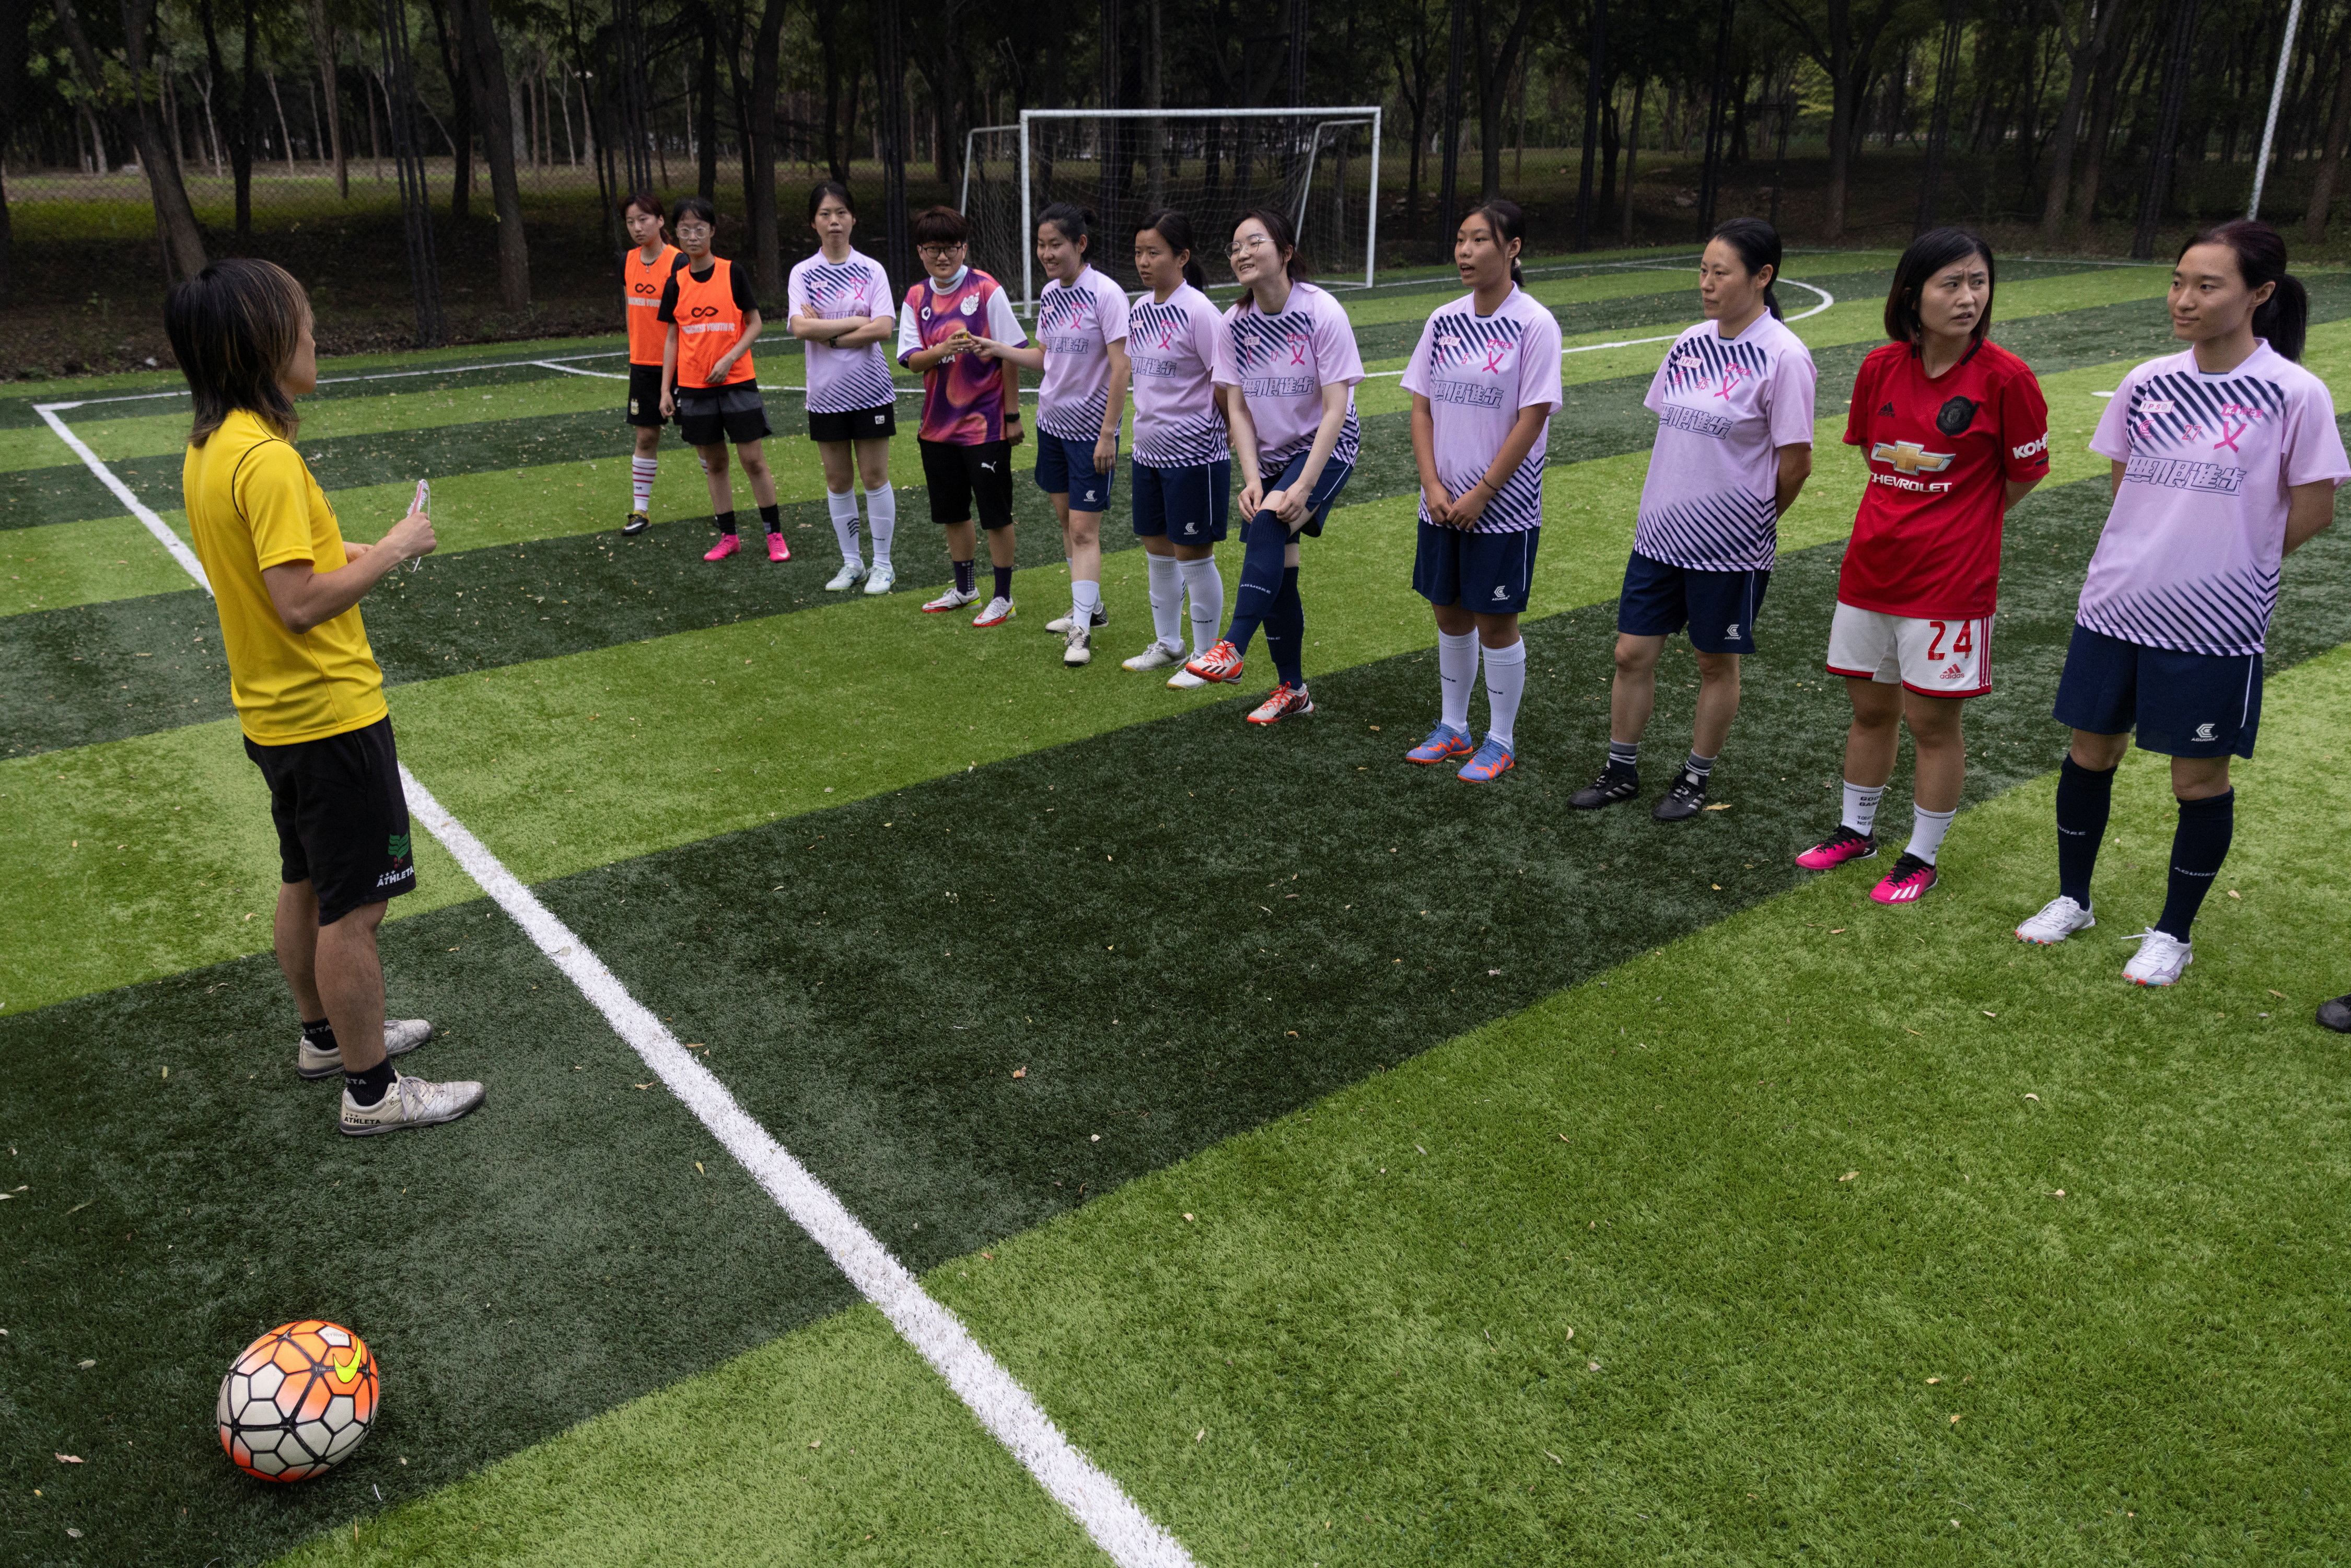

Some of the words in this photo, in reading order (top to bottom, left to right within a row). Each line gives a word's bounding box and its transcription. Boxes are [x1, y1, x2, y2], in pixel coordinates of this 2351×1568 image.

[1270, 351, 1279, 362] 17
[1461, 353, 1470, 364] 5
[1695, 376, 1710, 390] 35
[2182, 424, 2202, 441] 27
[1927, 620, 1972, 661] 24
[376, 865, 415, 887] ATHLETA
[344, 1116, 381, 1125] ATHLETA
